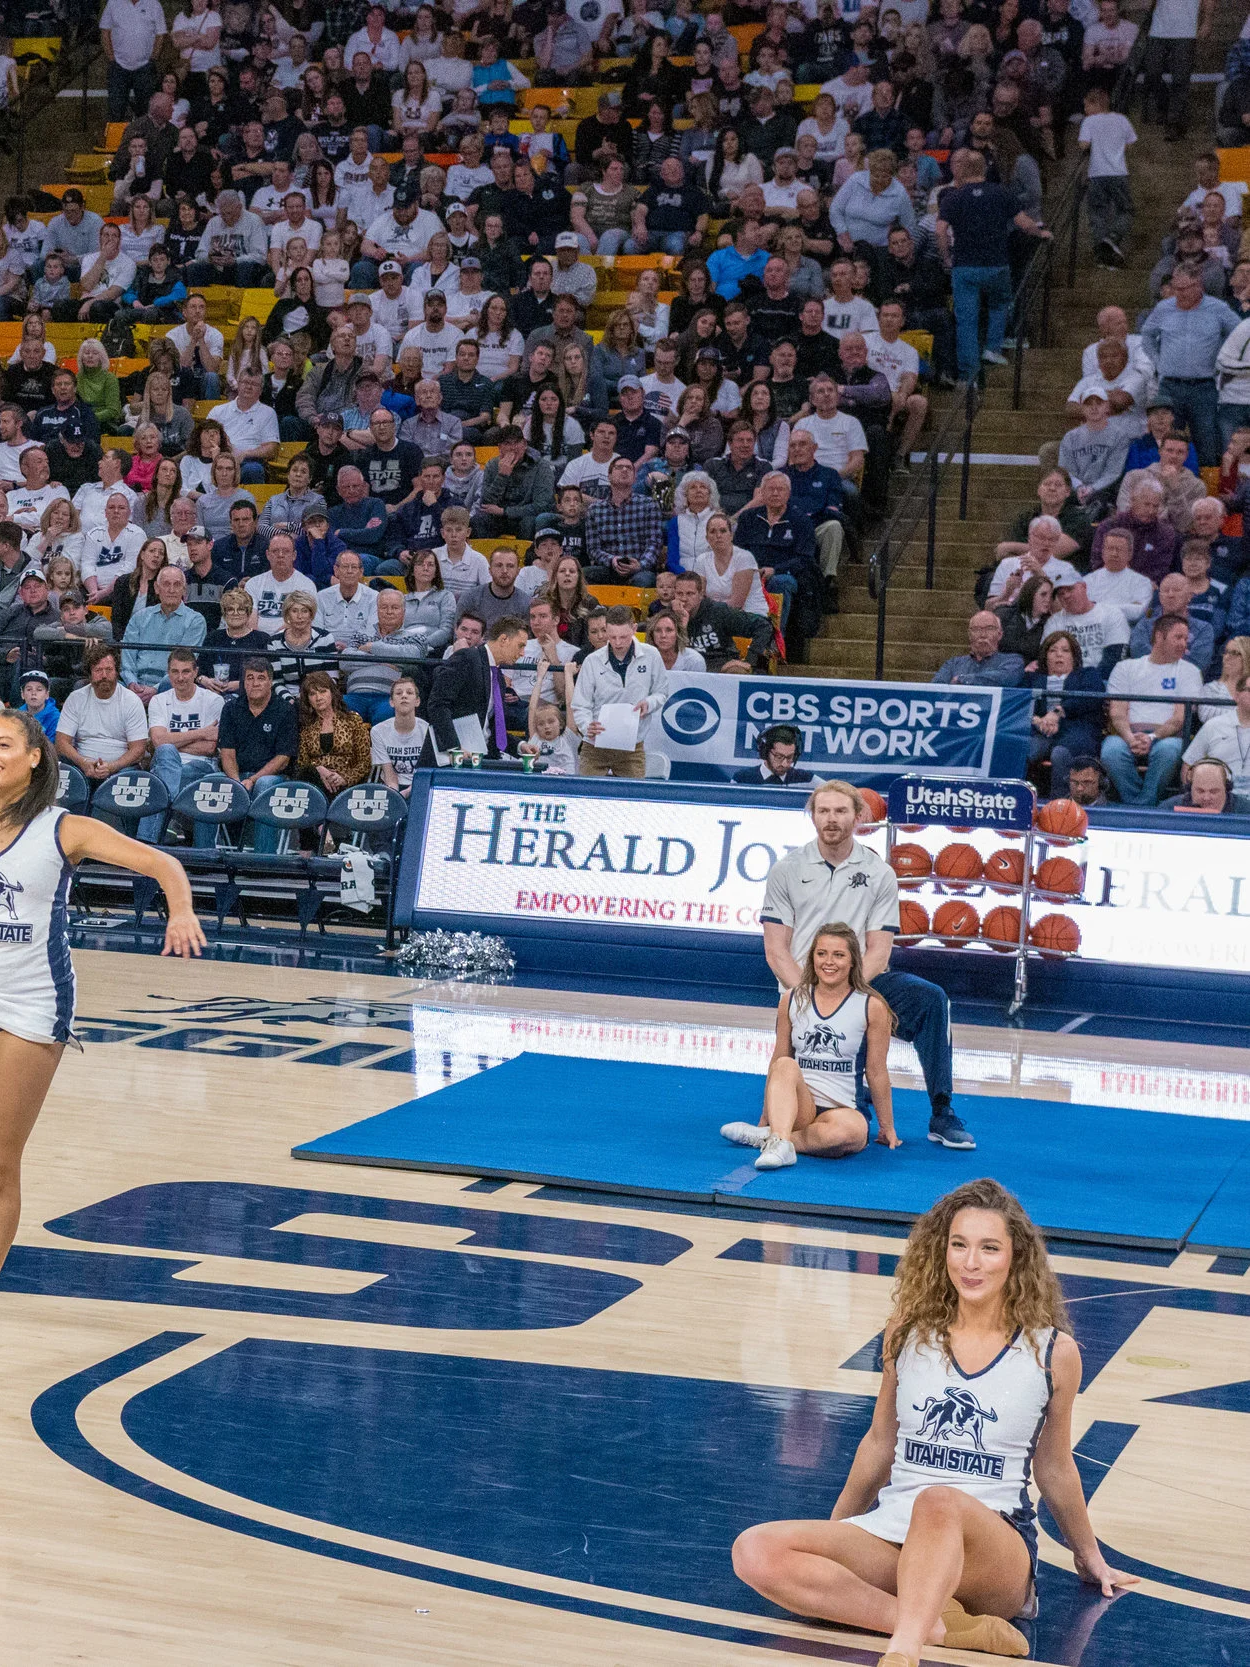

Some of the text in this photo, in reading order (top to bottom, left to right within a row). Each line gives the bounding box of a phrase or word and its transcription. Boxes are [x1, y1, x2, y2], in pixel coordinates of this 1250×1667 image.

[257, 601, 284, 611] STAT
[745, 691, 982, 729] CBS SPORTS
[170, 720, 201, 728] STATE
[386, 746, 421, 755] UTAH STATE
[744, 722, 941, 757] NTWORK
[906, 786, 1017, 810] UtahState
[519, 801, 566, 824] THE
[905, 804, 1017, 821] BASKETBALL
[444, 803, 800, 893] HERALD JO
[515, 889, 676, 923] EMPOWERING
[682, 901, 729, 925] THE
[798, 1057, 853, 1073] UTAH STATE
[905, 1438, 1005, 1480] UTAH STATE
